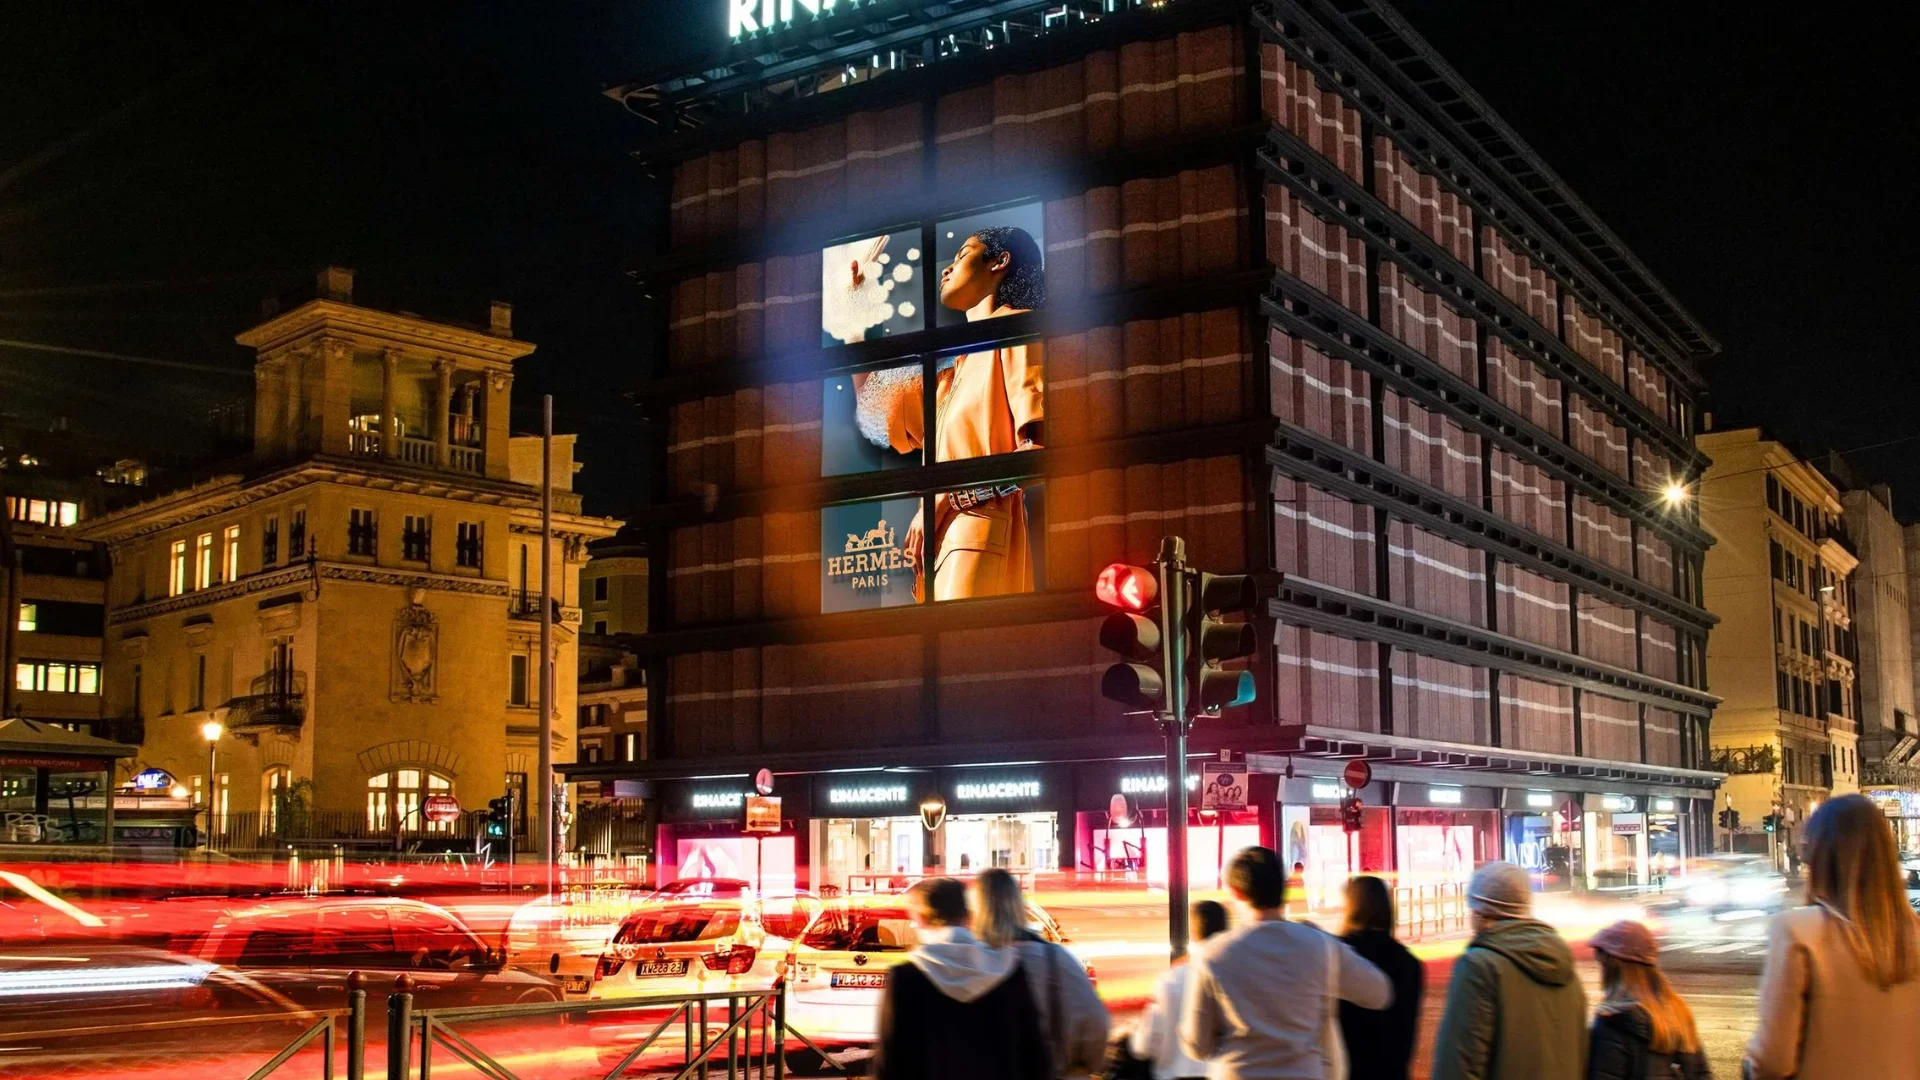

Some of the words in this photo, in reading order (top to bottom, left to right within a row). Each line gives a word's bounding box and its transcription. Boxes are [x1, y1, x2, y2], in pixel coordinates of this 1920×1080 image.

[729, 0, 858, 37] RIN
[827, 547, 917, 576] HERMÈS
[852, 574, 888, 589] PARIS
[957, 782, 1039, 798] RINASCENTE
[1122, 776, 1200, 792] RINAS
[693, 792, 760, 808] RINASCE
[830, 787, 907, 802] RINASCENTE
